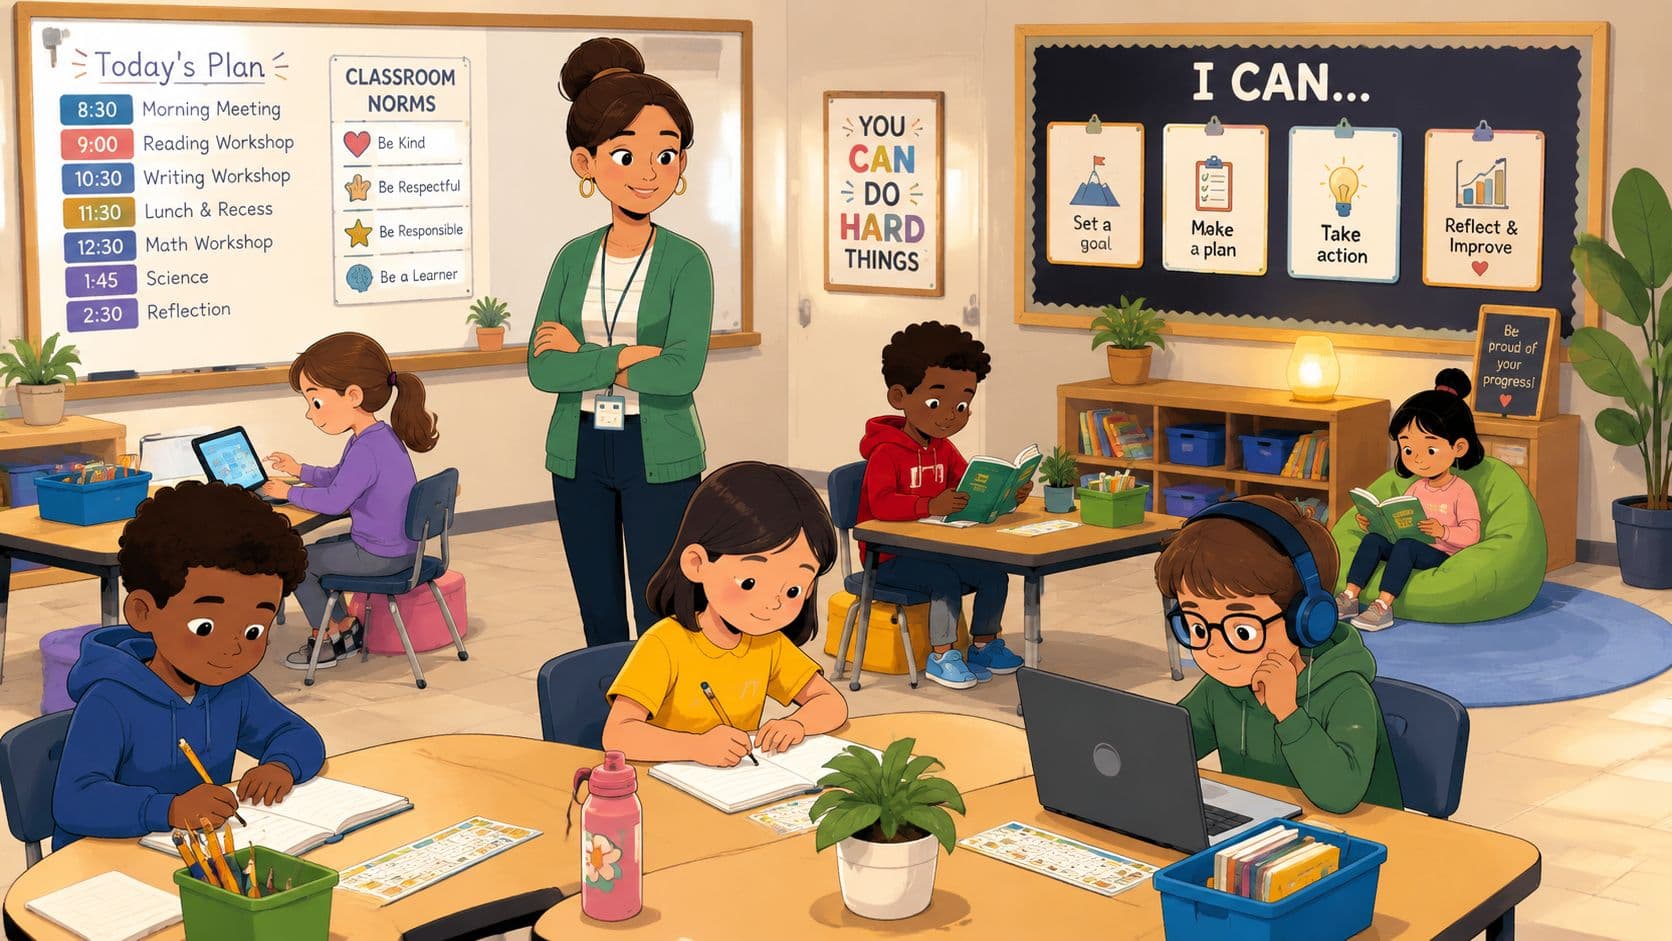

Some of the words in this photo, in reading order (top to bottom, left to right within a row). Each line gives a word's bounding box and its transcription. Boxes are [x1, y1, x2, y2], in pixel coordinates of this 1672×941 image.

[95, 51, 195, 85] Today's
[208, 51, 266, 78] Plan
[345, 67, 456, 86] CLASSROOM
[1192, 61, 1214, 101] I
[1231, 61, 1370, 103] CAN...
[78, 100, 117, 118] 8:30
[142, 100, 210, 121] Morning
[216, 100, 281, 121] Meeting
[368, 94, 436, 113] NORMS
[859, 115, 905, 137] YOU
[77, 135, 118, 154] 9:00
[143, 134, 210, 156] Reading
[215, 133, 295, 154] Workshop
[378, 135, 394, 150] Be
[398, 135, 426, 150] Kind
[848, 143, 915, 174] CAN
[74, 170, 122, 188] 10:30
[143, 169, 205, 190] Writing
[211, 166, 291, 188] Workshop
[378, 180, 394, 194] Be
[398, 178, 461, 197] Respectful
[864, 181, 900, 207] DO
[78, 204, 122, 222] 11:30
[145, 201, 194, 220] Lunch
[199, 201, 212, 218] &
[218, 201, 273, 217] Recess
[379, 225, 395, 239] Be
[398, 223, 464, 240] Responsible
[840, 212, 925, 244] HARD
[1073, 214, 1099, 232] Set
[1102, 220, 1112, 232] a
[1191, 219, 1234, 237] Make
[1445, 217, 1501, 235] Reflect
[1506, 219, 1518, 236] &
[1320, 223, 1361, 243] Take
[77, 238, 124, 256] 12:30
[146, 235, 188, 253] Math
[194, 234, 274, 254] Workshop
[1080, 236, 1112, 254] goal
[1190, 244, 1200, 256] a
[1203, 240, 1237, 261] plan
[1450, 237, 1512, 257] Improve
[844, 248, 920, 272] THINGS
[1317, 247, 1368, 264] action
[84, 271, 118, 289] 1:45
[146, 270, 209, 287] Science
[380, 270, 396, 284] Be
[400, 273, 409, 283] a
[412, 268, 459, 282] Learner
[83, 306, 123, 324] 2:30
[147, 302, 231, 320] Reflection
[1504, 324, 1520, 338] Be
[1489, 342, 1521, 353] proud
[1525, 342, 1538, 354] of
[1496, 360, 1521, 372] your
